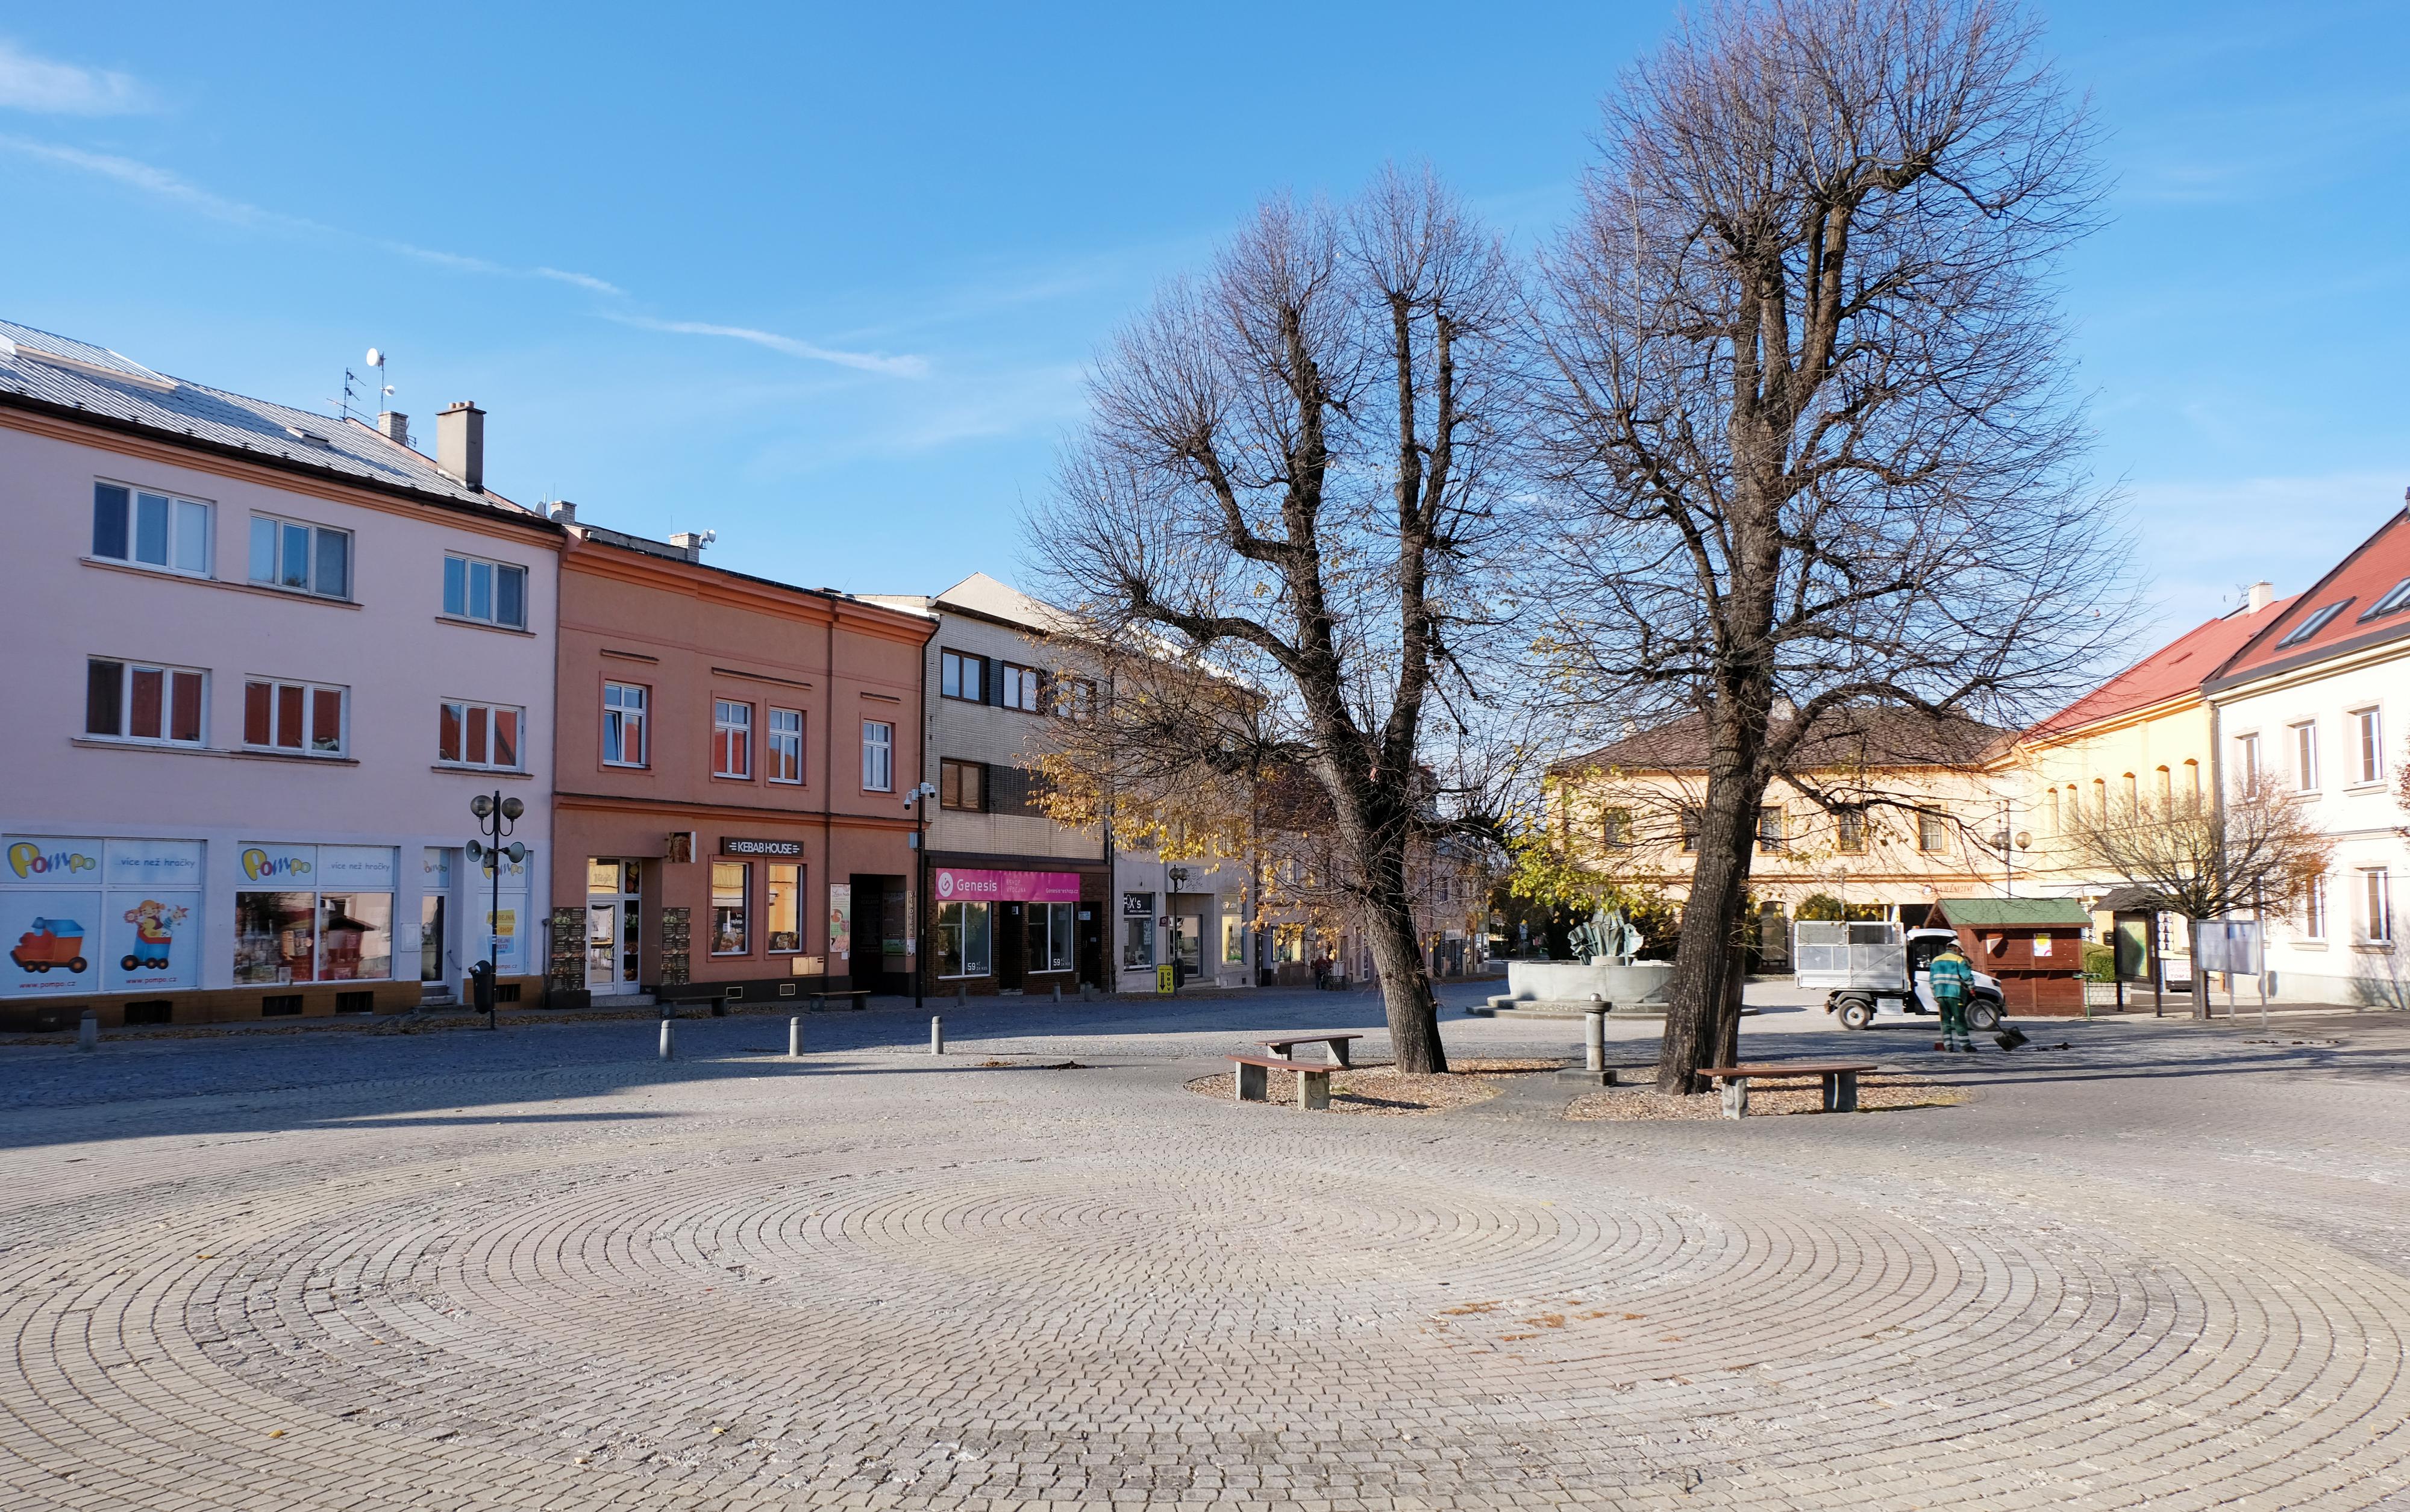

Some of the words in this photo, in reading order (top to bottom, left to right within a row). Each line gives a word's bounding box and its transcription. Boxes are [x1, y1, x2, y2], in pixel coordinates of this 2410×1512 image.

[738, 842, 764, 852] KEBAB
[765, 843, 792, 854] HOUSE
[144, 858, 160, 866] než
[164, 858, 195, 869] hračky
[349, 861, 362, 870] než
[365, 862, 390, 872] hračky
[957, 878, 997, 892] Genesis
[968, 963, 976, 971] 59
